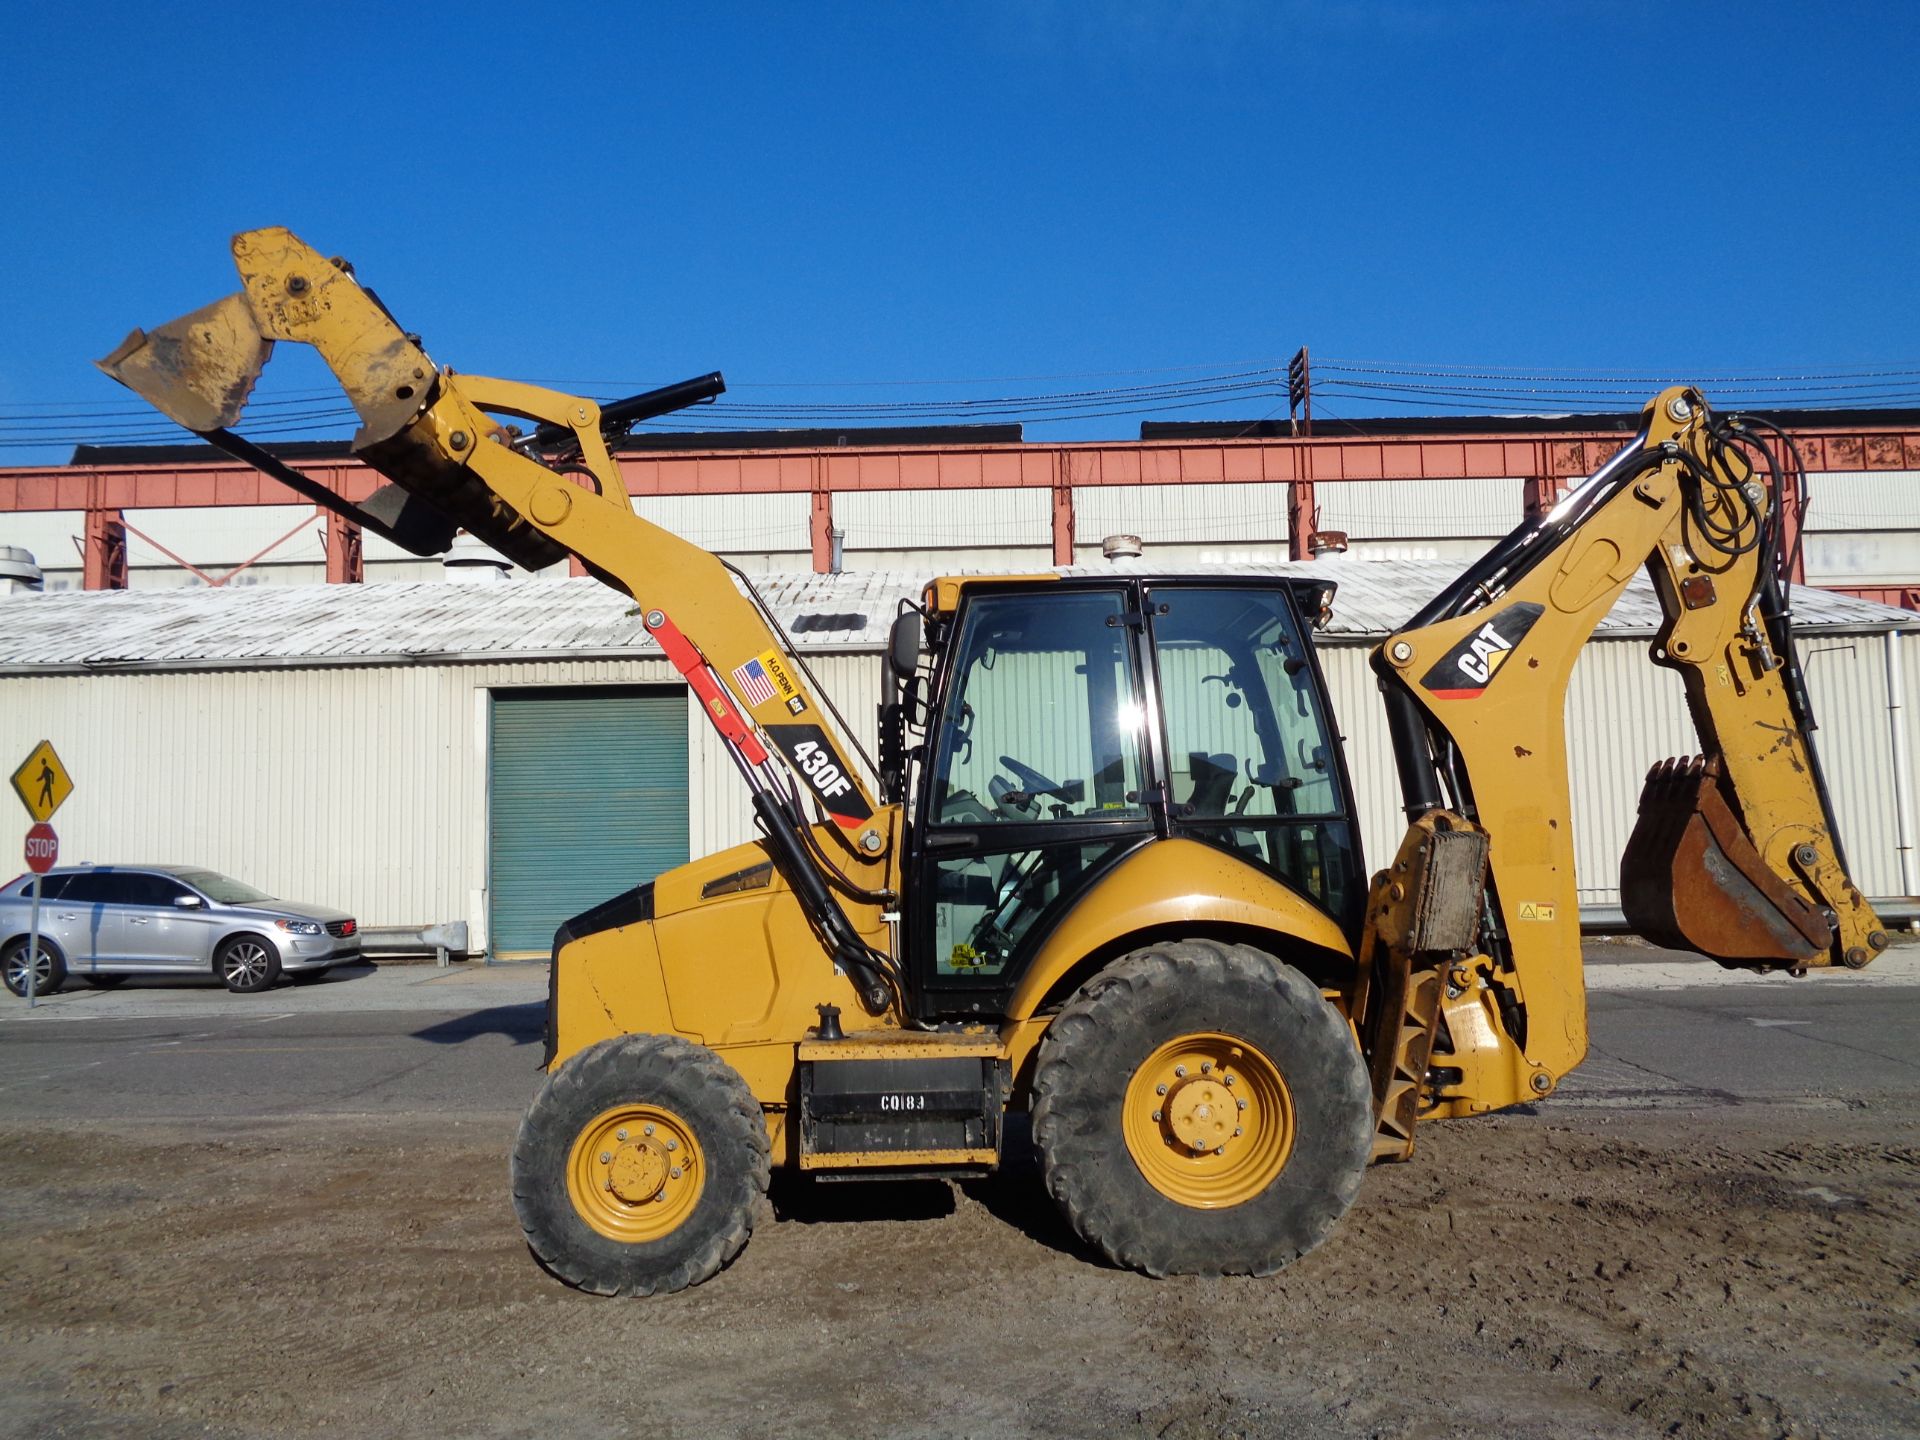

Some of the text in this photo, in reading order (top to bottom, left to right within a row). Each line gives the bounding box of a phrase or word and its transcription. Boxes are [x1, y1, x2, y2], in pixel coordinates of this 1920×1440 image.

[1457, 622, 1512, 684] CAT
[789, 697, 804, 714] CAT
[794, 740, 852, 798] 430F
[26, 838, 57, 858] STOP
